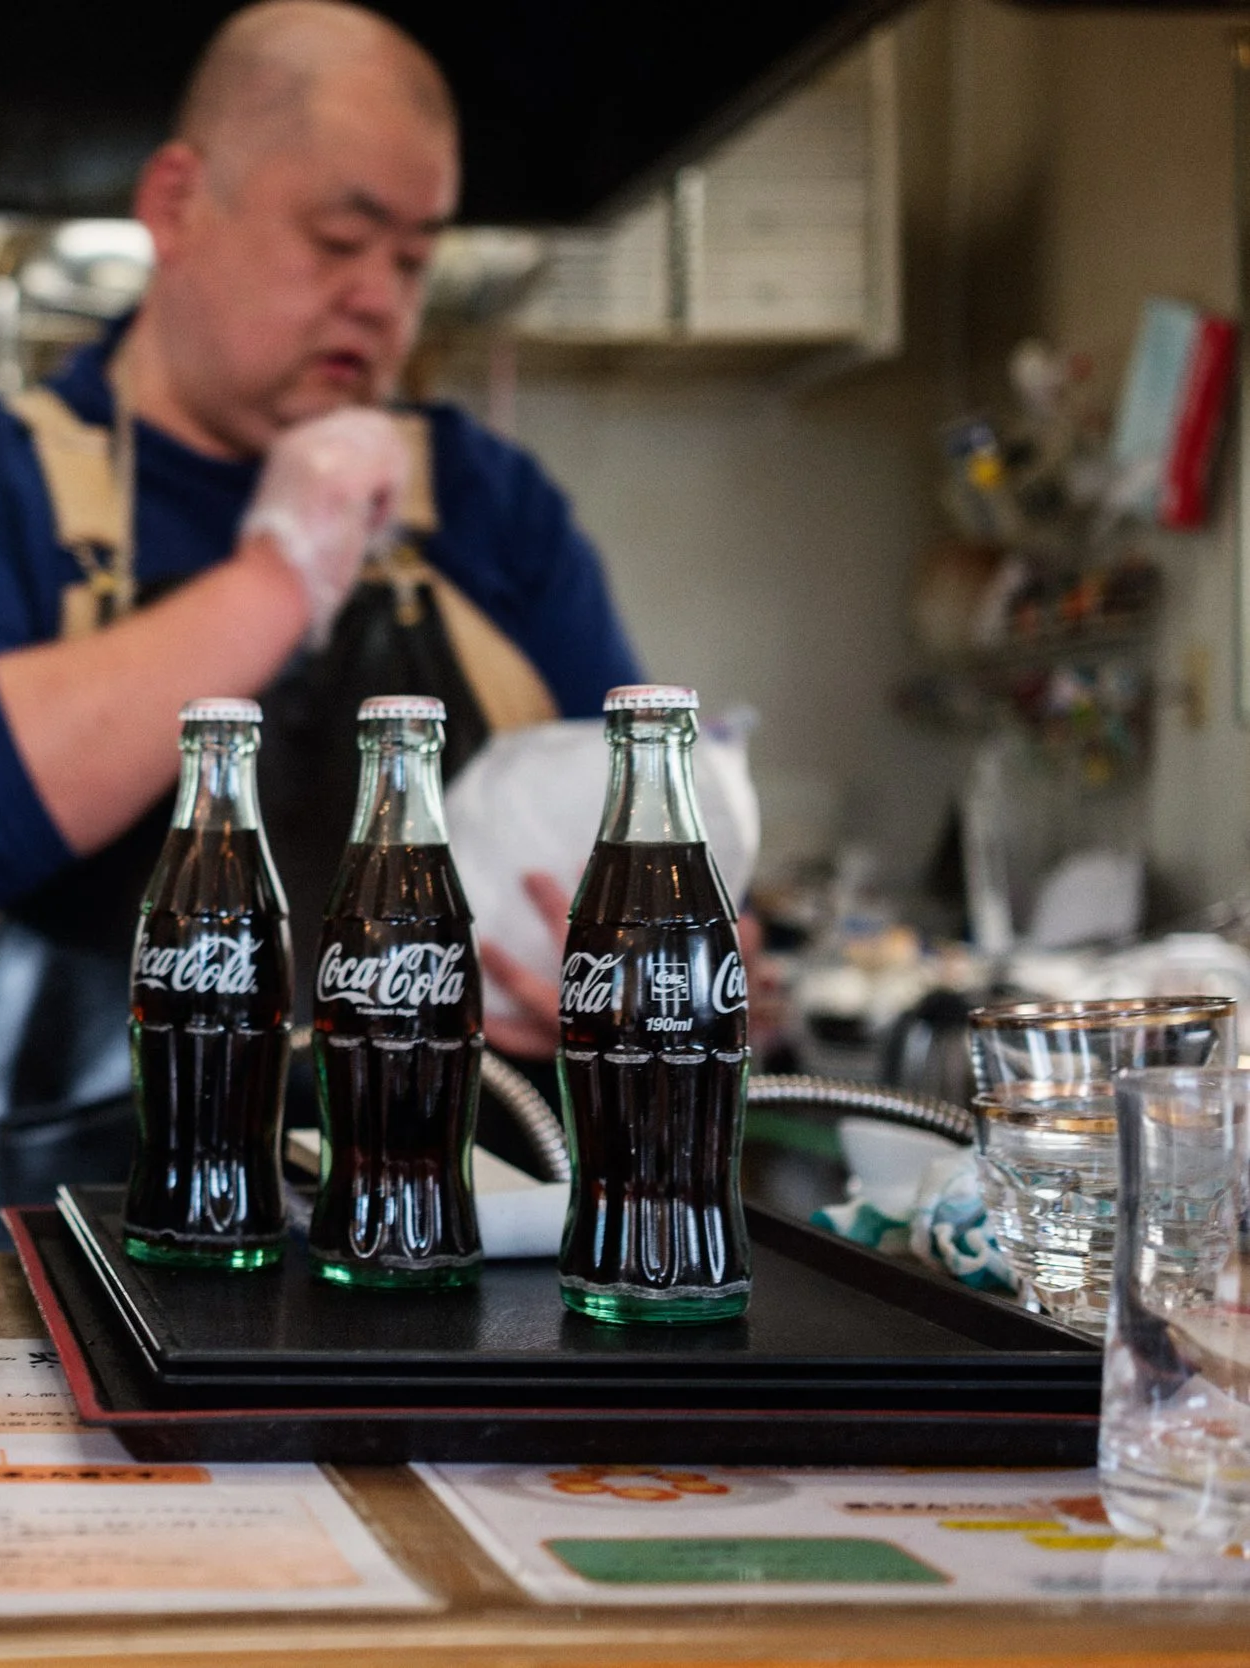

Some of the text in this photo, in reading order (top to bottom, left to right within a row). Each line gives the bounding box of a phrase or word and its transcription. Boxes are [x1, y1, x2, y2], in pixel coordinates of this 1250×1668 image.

[317, 942, 465, 1006] Coca-Cola
[656, 971, 686, 986] Coke
[645, 1017, 693, 1032] 190ml
